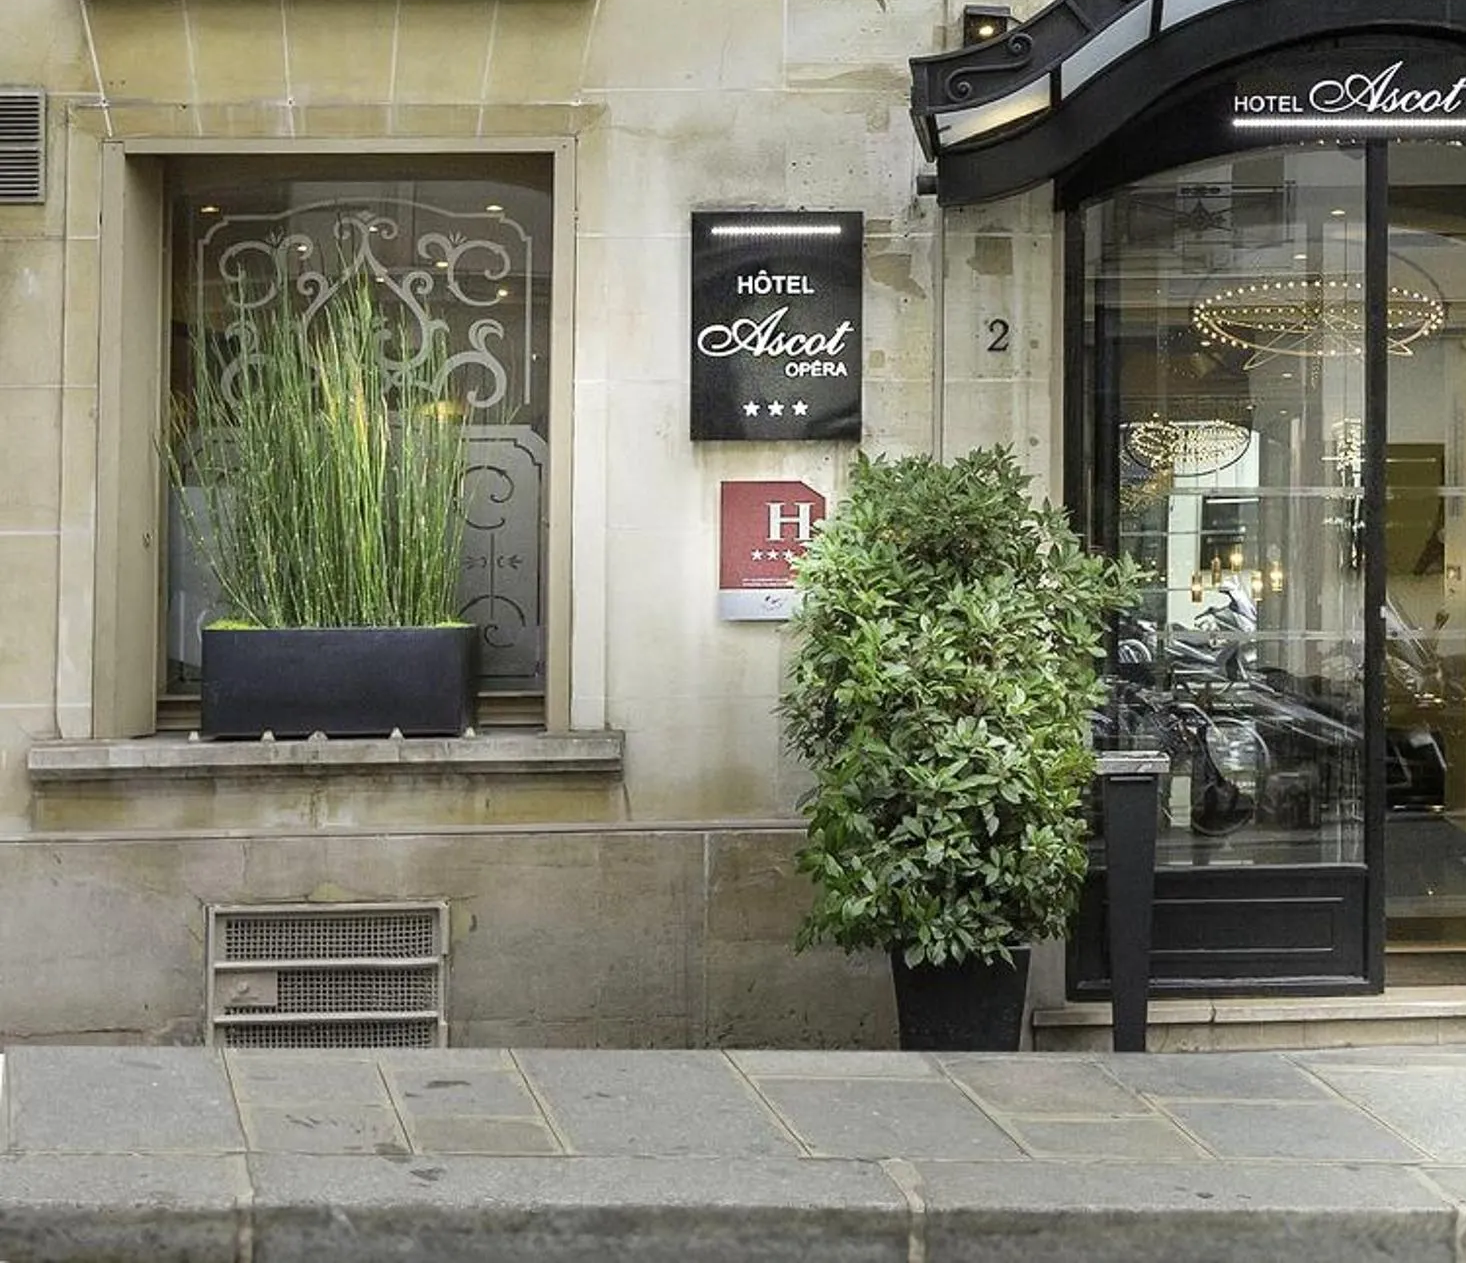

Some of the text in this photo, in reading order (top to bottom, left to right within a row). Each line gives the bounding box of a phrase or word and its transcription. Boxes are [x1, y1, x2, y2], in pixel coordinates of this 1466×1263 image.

[1234, 95, 1304, 113] HOTEL
[737, 269, 815, 294] HÔTEL
[697, 306, 855, 357] Ascot
[987, 319, 1009, 352] 2
[785, 359, 848, 378] OPÉRA
[765, 501, 816, 541] H
